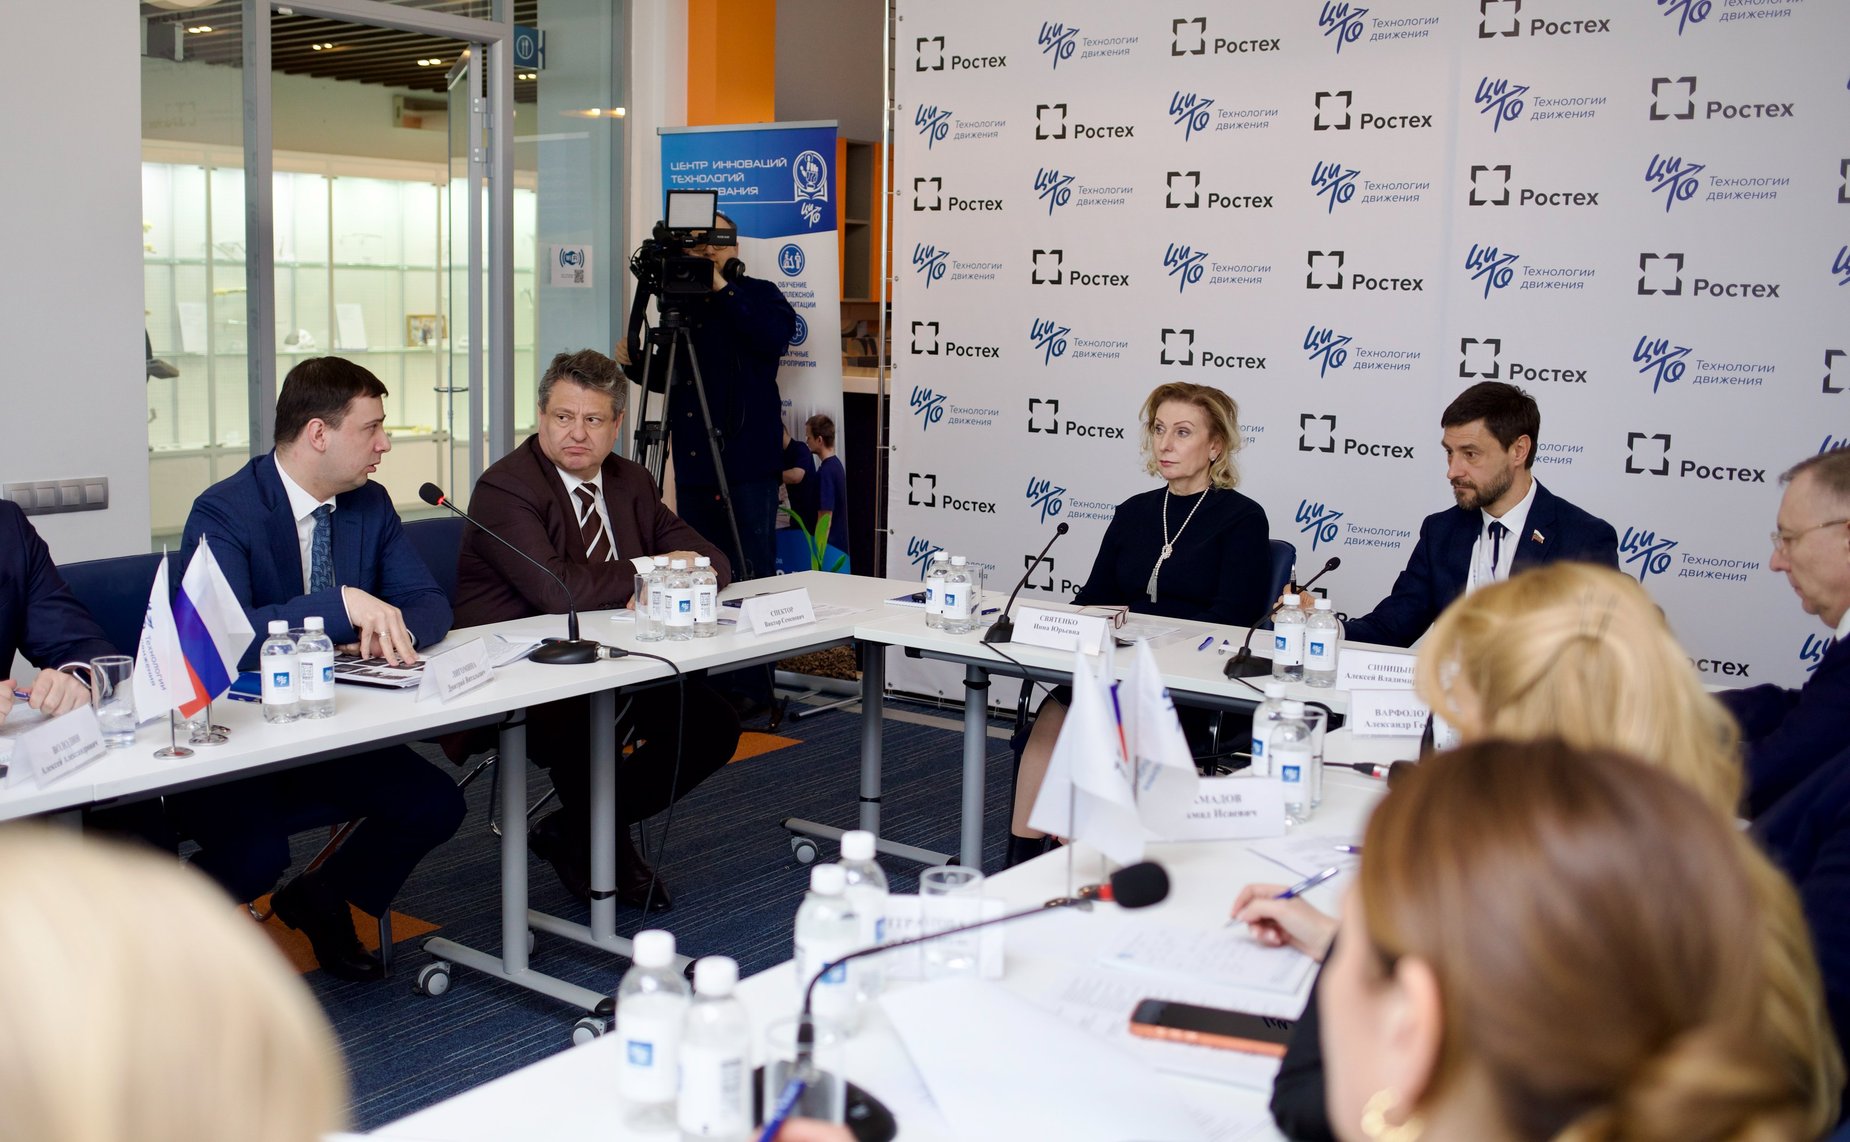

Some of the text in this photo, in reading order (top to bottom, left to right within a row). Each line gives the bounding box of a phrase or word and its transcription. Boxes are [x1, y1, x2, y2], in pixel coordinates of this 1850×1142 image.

[1718, 8, 1792, 23] движения
[1371, 16, 1440, 29] Технологии
[1530, 18, 1611, 37] Ростех
[1082, 36, 1139, 47] Технологии
[1369, 29, 1429, 43] движения
[1214, 38, 1281, 55] Ростех
[1080, 48, 1131, 60] движения
[951, 55, 1007, 71] Ростех
[1533, 96, 1607, 107] Технологии
[1217, 108, 1279, 119] Технологии
[1529, 109, 1596, 122] движения
[1706, 101, 1794, 120] Ростех
[955, 119, 1006, 129] Технологии
[1215, 121, 1270, 132] движения
[1360, 112, 1433, 130] Ростех
[953, 131, 999, 141] движения
[1074, 123, 1135, 140] Ростех
[670, 157, 788, 171] ЦЕНТР ИННОВАЦИЙ
[670, 172, 745, 184] ТЕХНОЛОГИЙ
[1709, 175, 1790, 187] Технологии
[1077, 185, 1134, 195] Технологии
[1363, 180, 1430, 191] Технологии
[1075, 197, 1126, 208] движения
[1207, 192, 1274, 209] Ростех
[1360, 194, 1420, 205] движения
[1519, 188, 1600, 207] Ростех
[1705, 191, 1778, 202] движения
[948, 196, 1003, 212] Ростех
[951, 260, 1003, 270] Технологии
[1211, 262, 1272, 273] Технологии
[1522, 265, 1596, 277] Технологии
[950, 272, 996, 281] движения
[1069, 270, 1130, 287] Ростех
[1208, 276, 1263, 285] движения
[1352, 273, 1424, 292] Ростех
[1519, 280, 1585, 291] движения
[1693, 278, 1781, 298] Ростех
[783, 290, 815, 298] ПЛЕКСНОЙ
[1073, 337, 1129, 349] Технологии
[785, 350, 809, 358] АУЧНЫЕ
[945, 341, 1000, 359] Ростех
[1071, 350, 1121, 359] движения
[1355, 346, 1421, 360] Технологии
[1201, 351, 1267, 370] Ростех
[1352, 361, 1411, 371] движения
[1695, 359, 1776, 373] Технологии
[1509, 363, 1588, 384] Ростех
[1692, 375, 1763, 386] движения
[949, 404, 1000, 417] Технологии
[947, 416, 992, 426] движения
[1065, 420, 1125, 440] Ростех
[1343, 438, 1415, 459] Ростех
[1539, 442, 1584, 453] ологии
[1536, 455, 1573, 465] жения
[1680, 459, 1766, 483] Ростех
[942, 494, 996, 514] Ростех
[1068, 497, 1117, 510] Технологи
[1346, 522, 1411, 538] Технологии
[1343, 536, 1401, 549] движения
[1681, 552, 1760, 570] Технологии
[1677, 568, 1748, 583] движения
[1039, 614, 1079, 625] СВЯТЕНКО
[1050, 625, 1080, 635] Юрьевна
[1688, 657, 1750, 677] стех
[1344, 672, 1415, 686] Алексей Владимир
[1375, 708, 1425, 717] ВАРФОЛО
[1364, 720, 1412, 729] Александр
